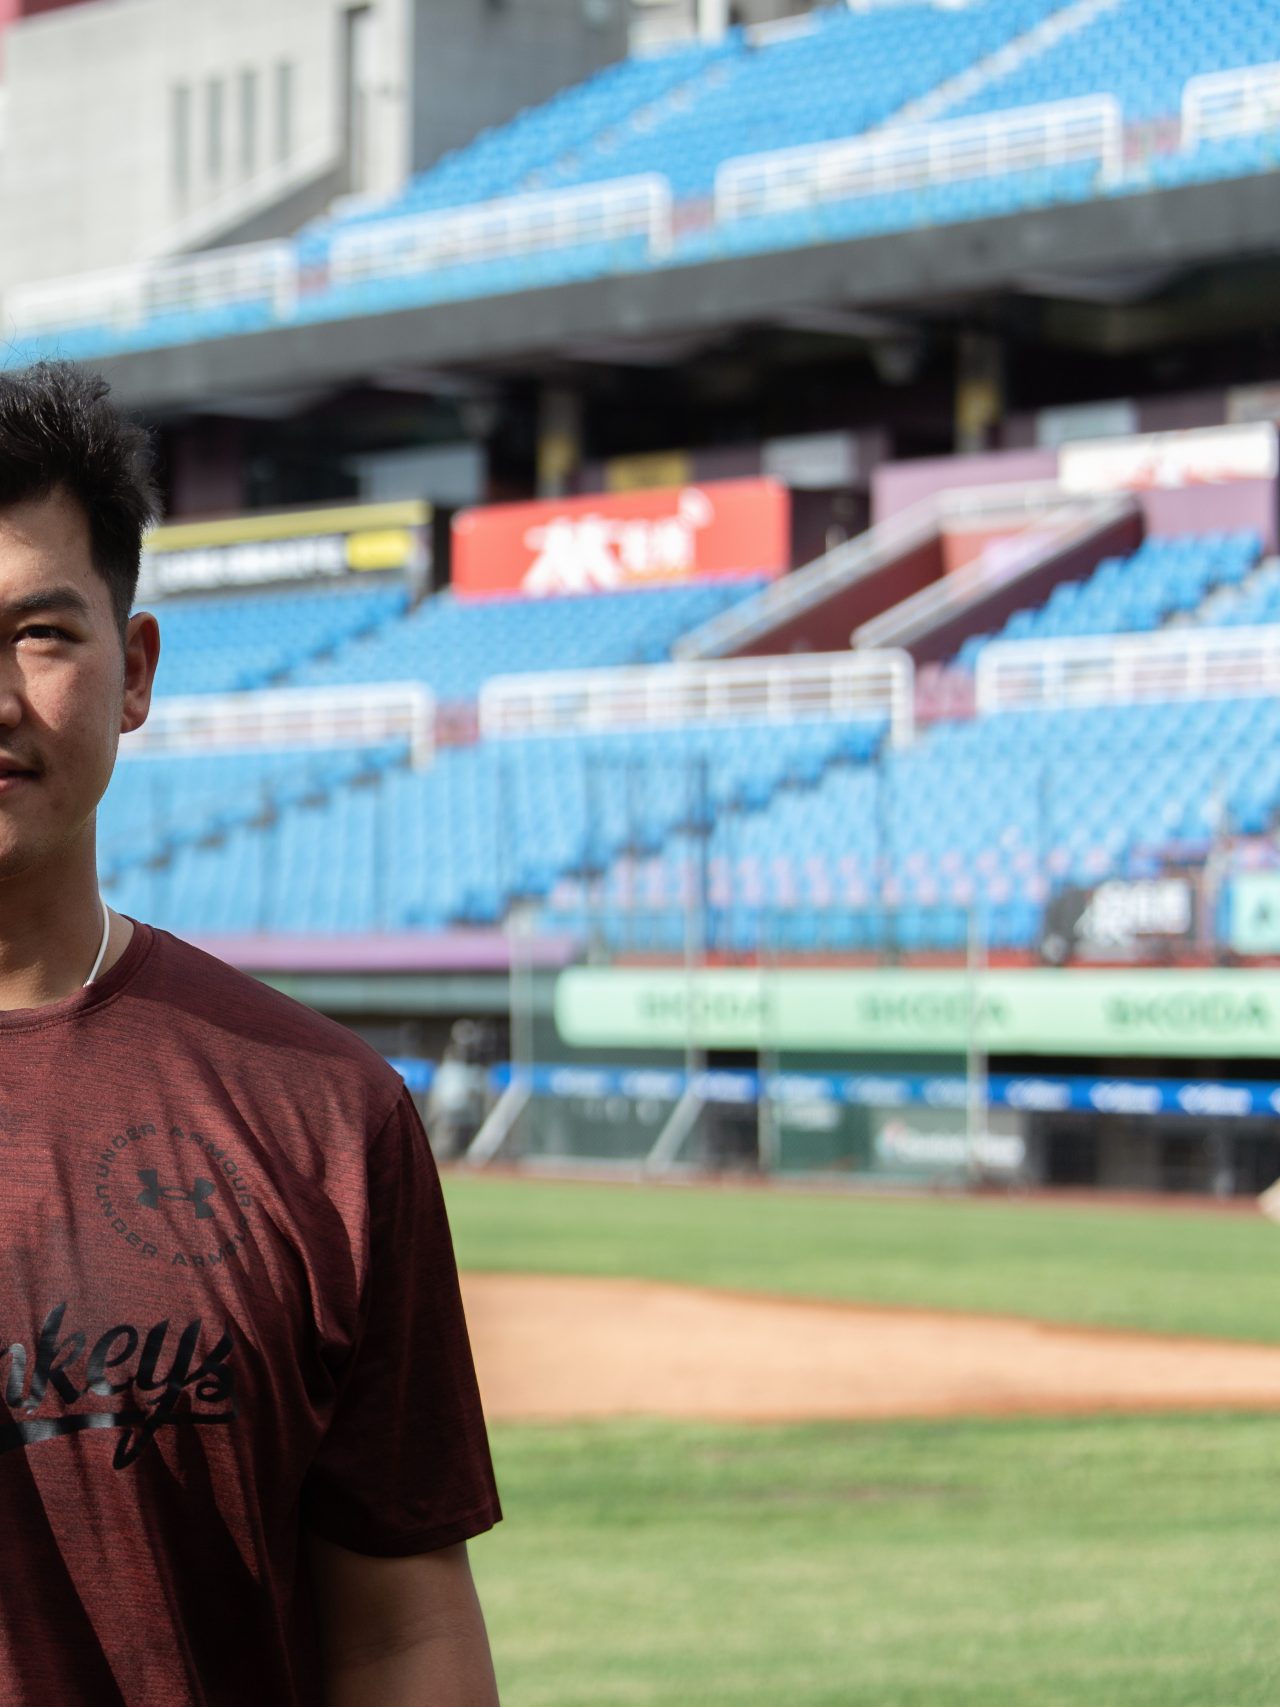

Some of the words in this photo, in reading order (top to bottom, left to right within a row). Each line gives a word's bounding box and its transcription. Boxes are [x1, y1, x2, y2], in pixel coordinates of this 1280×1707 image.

[96, 1123, 156, 1178] UNDER
[171, 1125, 252, 1208] ARMOUR
[96, 1184, 158, 1258] UNDER
